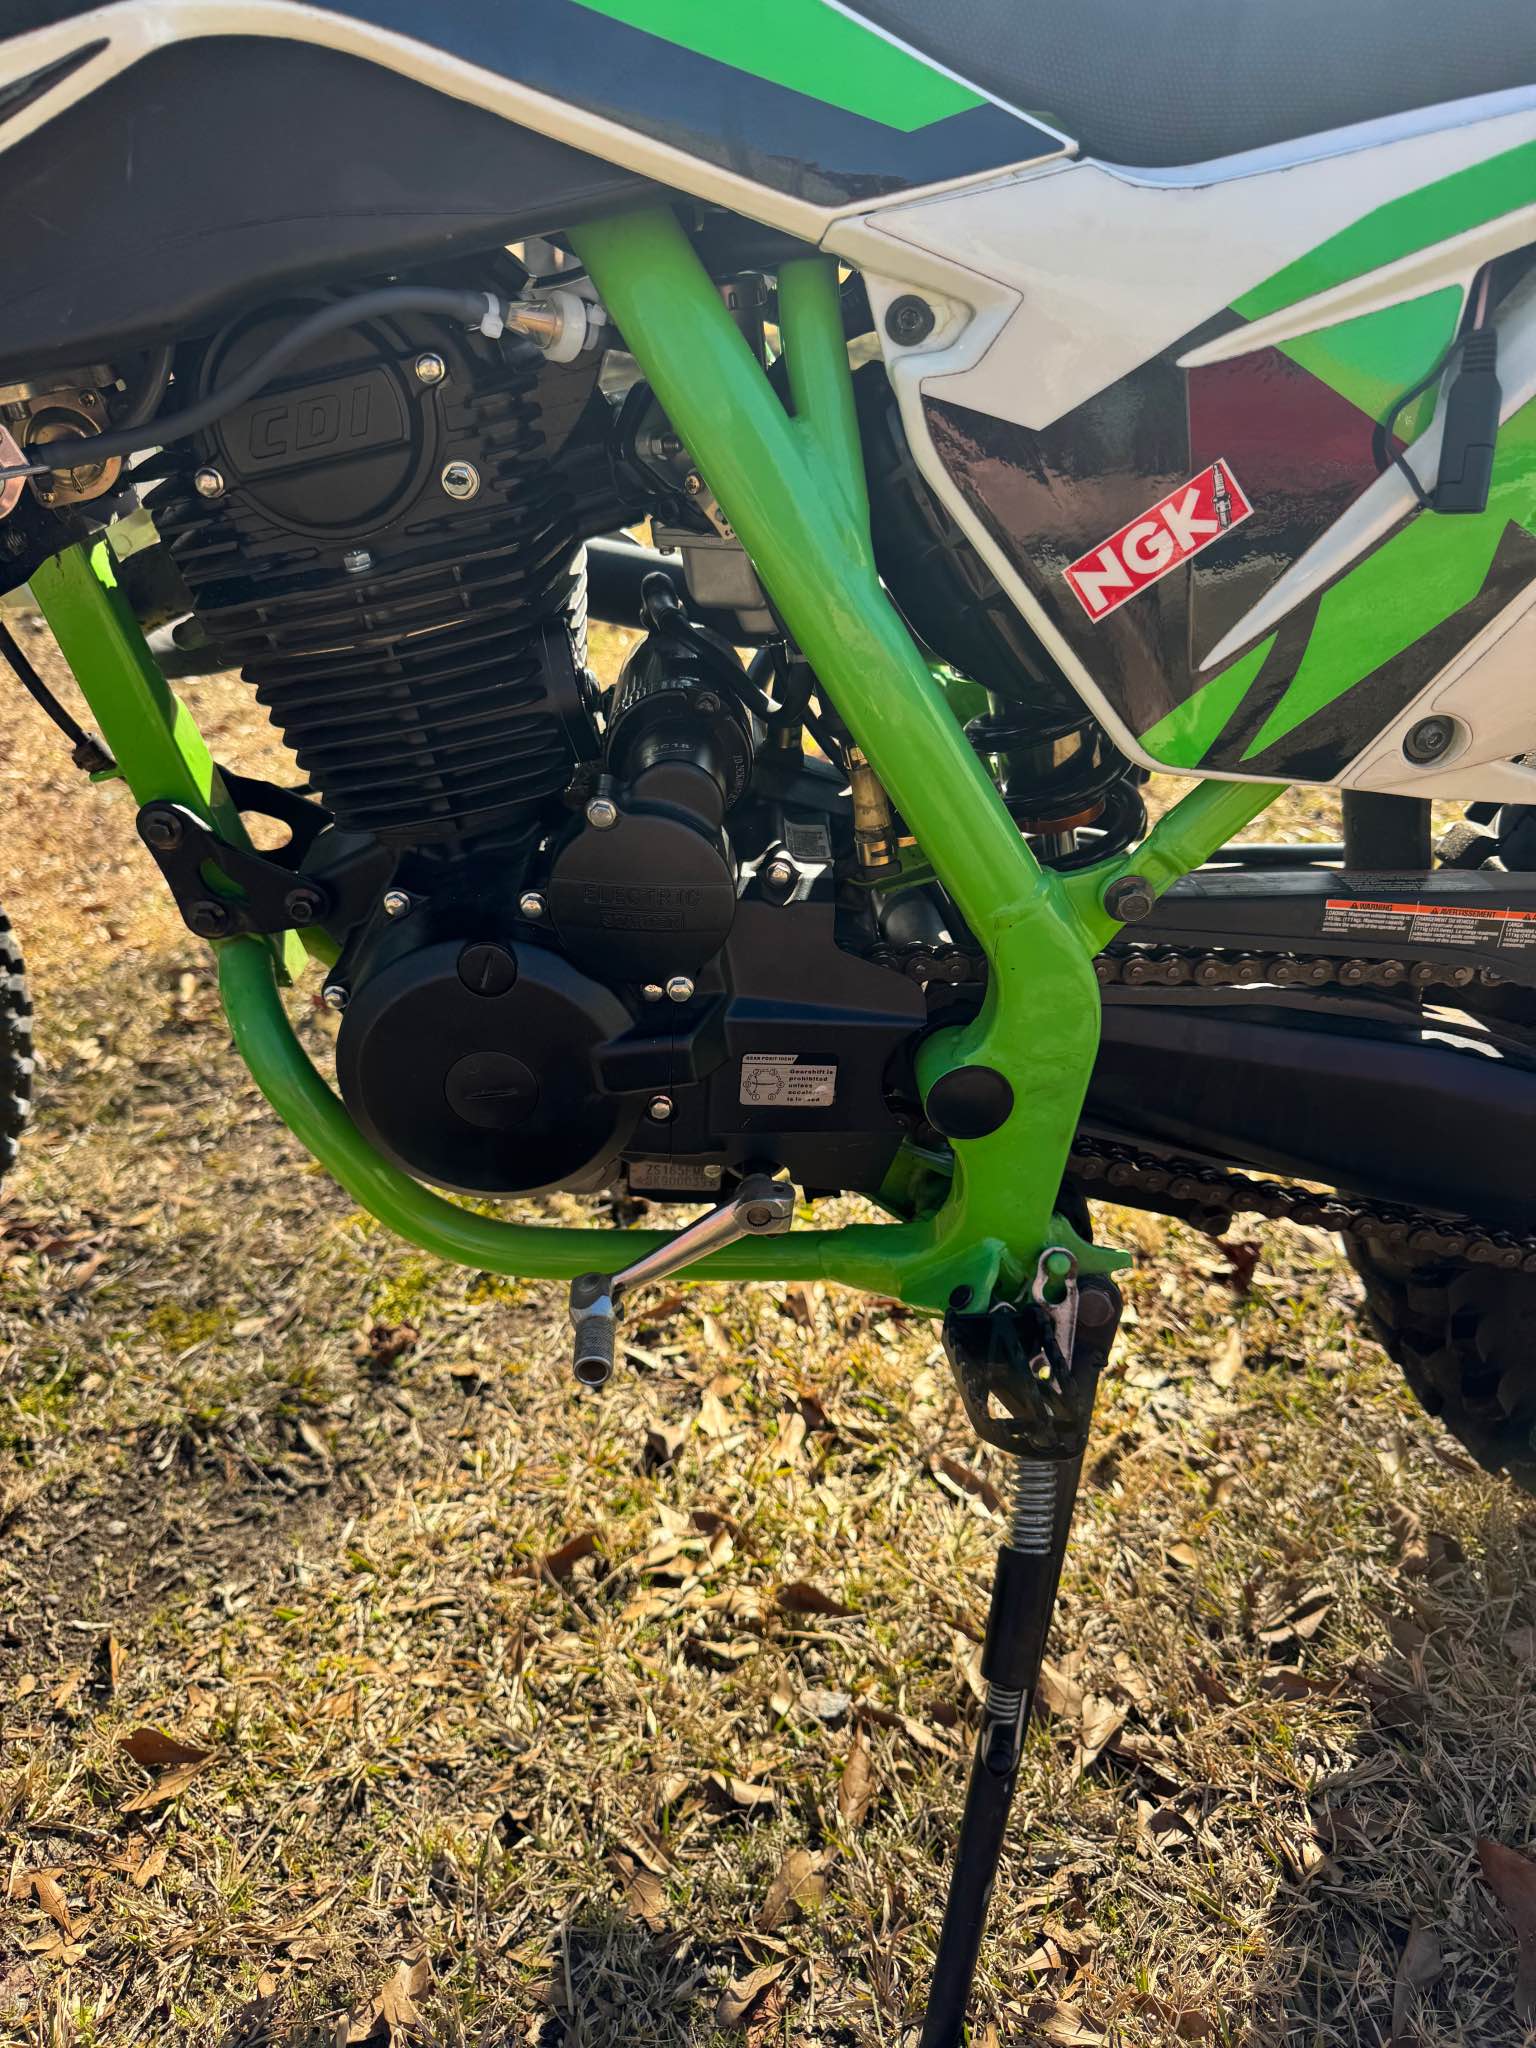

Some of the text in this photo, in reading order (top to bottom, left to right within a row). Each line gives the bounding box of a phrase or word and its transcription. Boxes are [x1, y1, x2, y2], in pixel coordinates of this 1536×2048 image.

[250, 384, 371, 460] CDI
[1072, 487, 1219, 613] NGK
[583, 884, 702, 906] ELECTRIC
[1359, 903, 1393, 912] WARNING
[1440, 908, 1497, 918] AVERTISSEMENT
